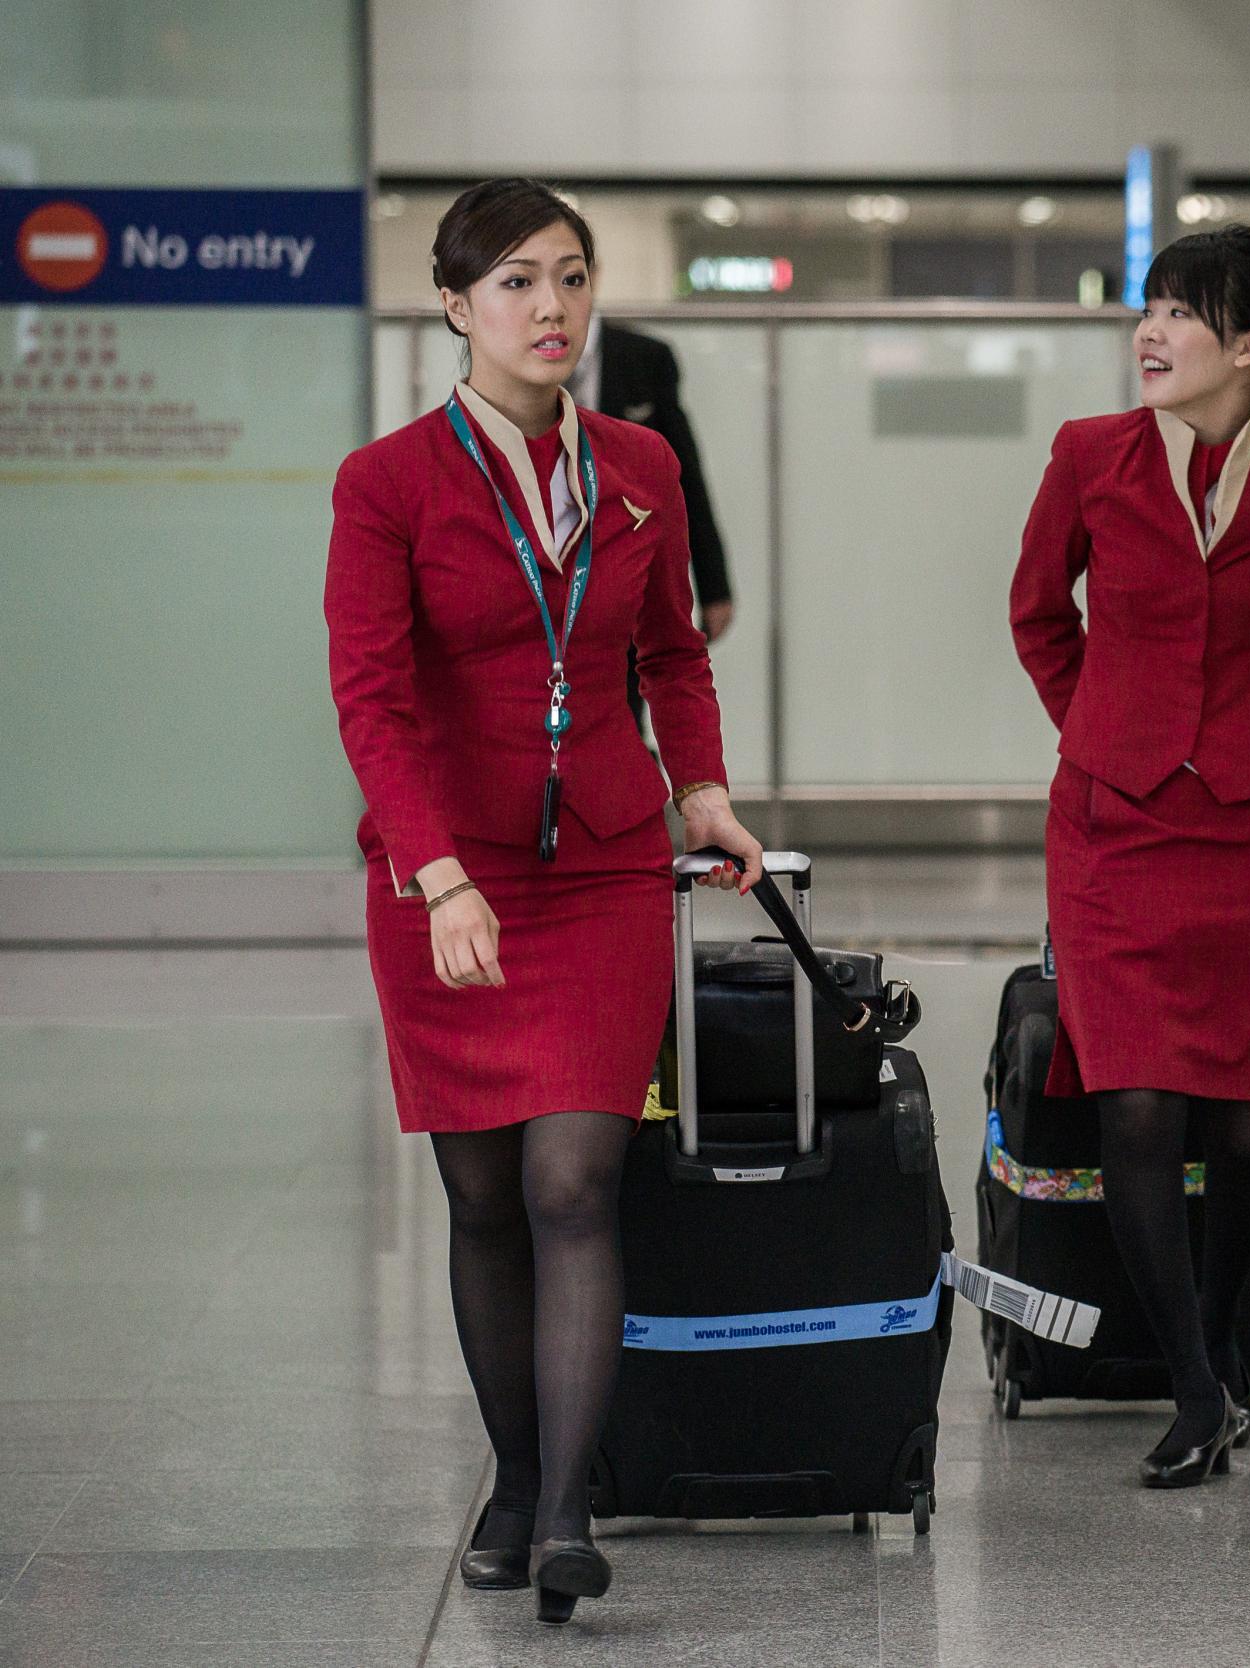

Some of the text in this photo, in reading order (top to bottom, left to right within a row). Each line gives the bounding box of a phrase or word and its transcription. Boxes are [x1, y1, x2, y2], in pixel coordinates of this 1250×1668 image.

[121, 225, 315, 277] No entry
[521, 553, 536, 580] CATHAY
[694, 1320, 836, 1339] www.jumbohostel.com
